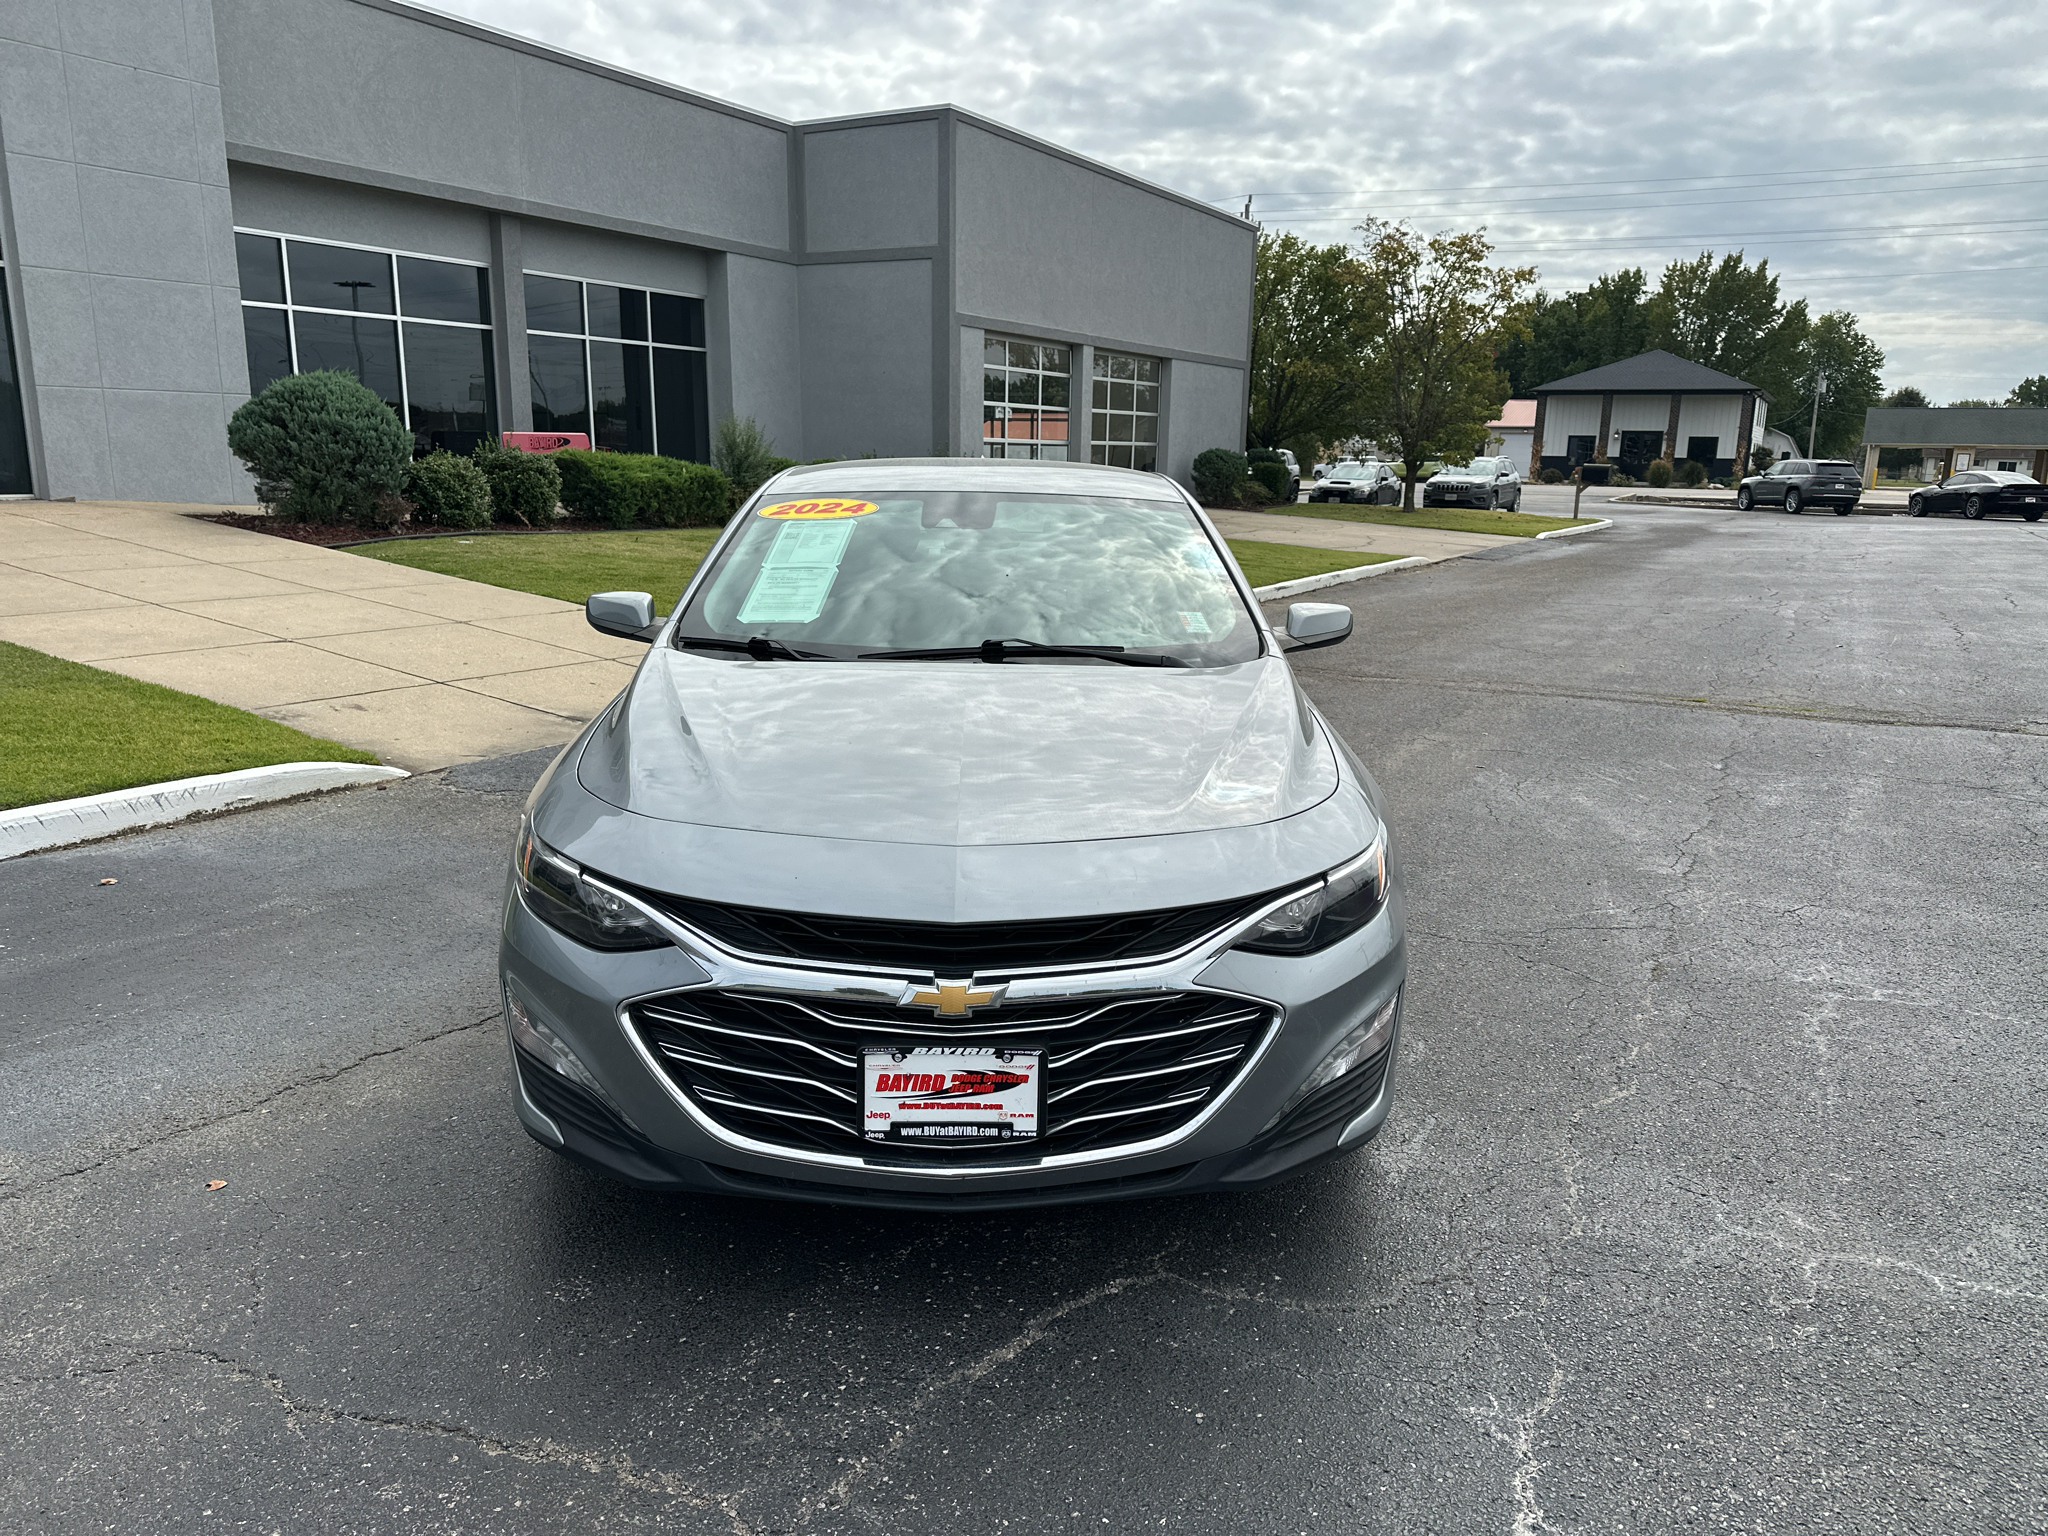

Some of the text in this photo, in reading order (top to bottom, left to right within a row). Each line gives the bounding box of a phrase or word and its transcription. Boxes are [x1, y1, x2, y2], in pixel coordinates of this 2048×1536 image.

[768, 502, 868, 516] 2024
[911, 1047, 996, 1056] BAYIRD
[875, 1073, 947, 1092] BAYIRD
[950, 1074, 1029, 1083] DODGE CHRYSLER
[948, 1084, 995, 1093] JEEP RAM
[898, 1102, 1003, 1110] www.BUYatBAYIRD.com
[866, 1110, 891, 1120] Jeep
[865, 1131, 883, 1139] Jeep
[900, 1126, 998, 1136] www.BUYatBAYIRD.com
